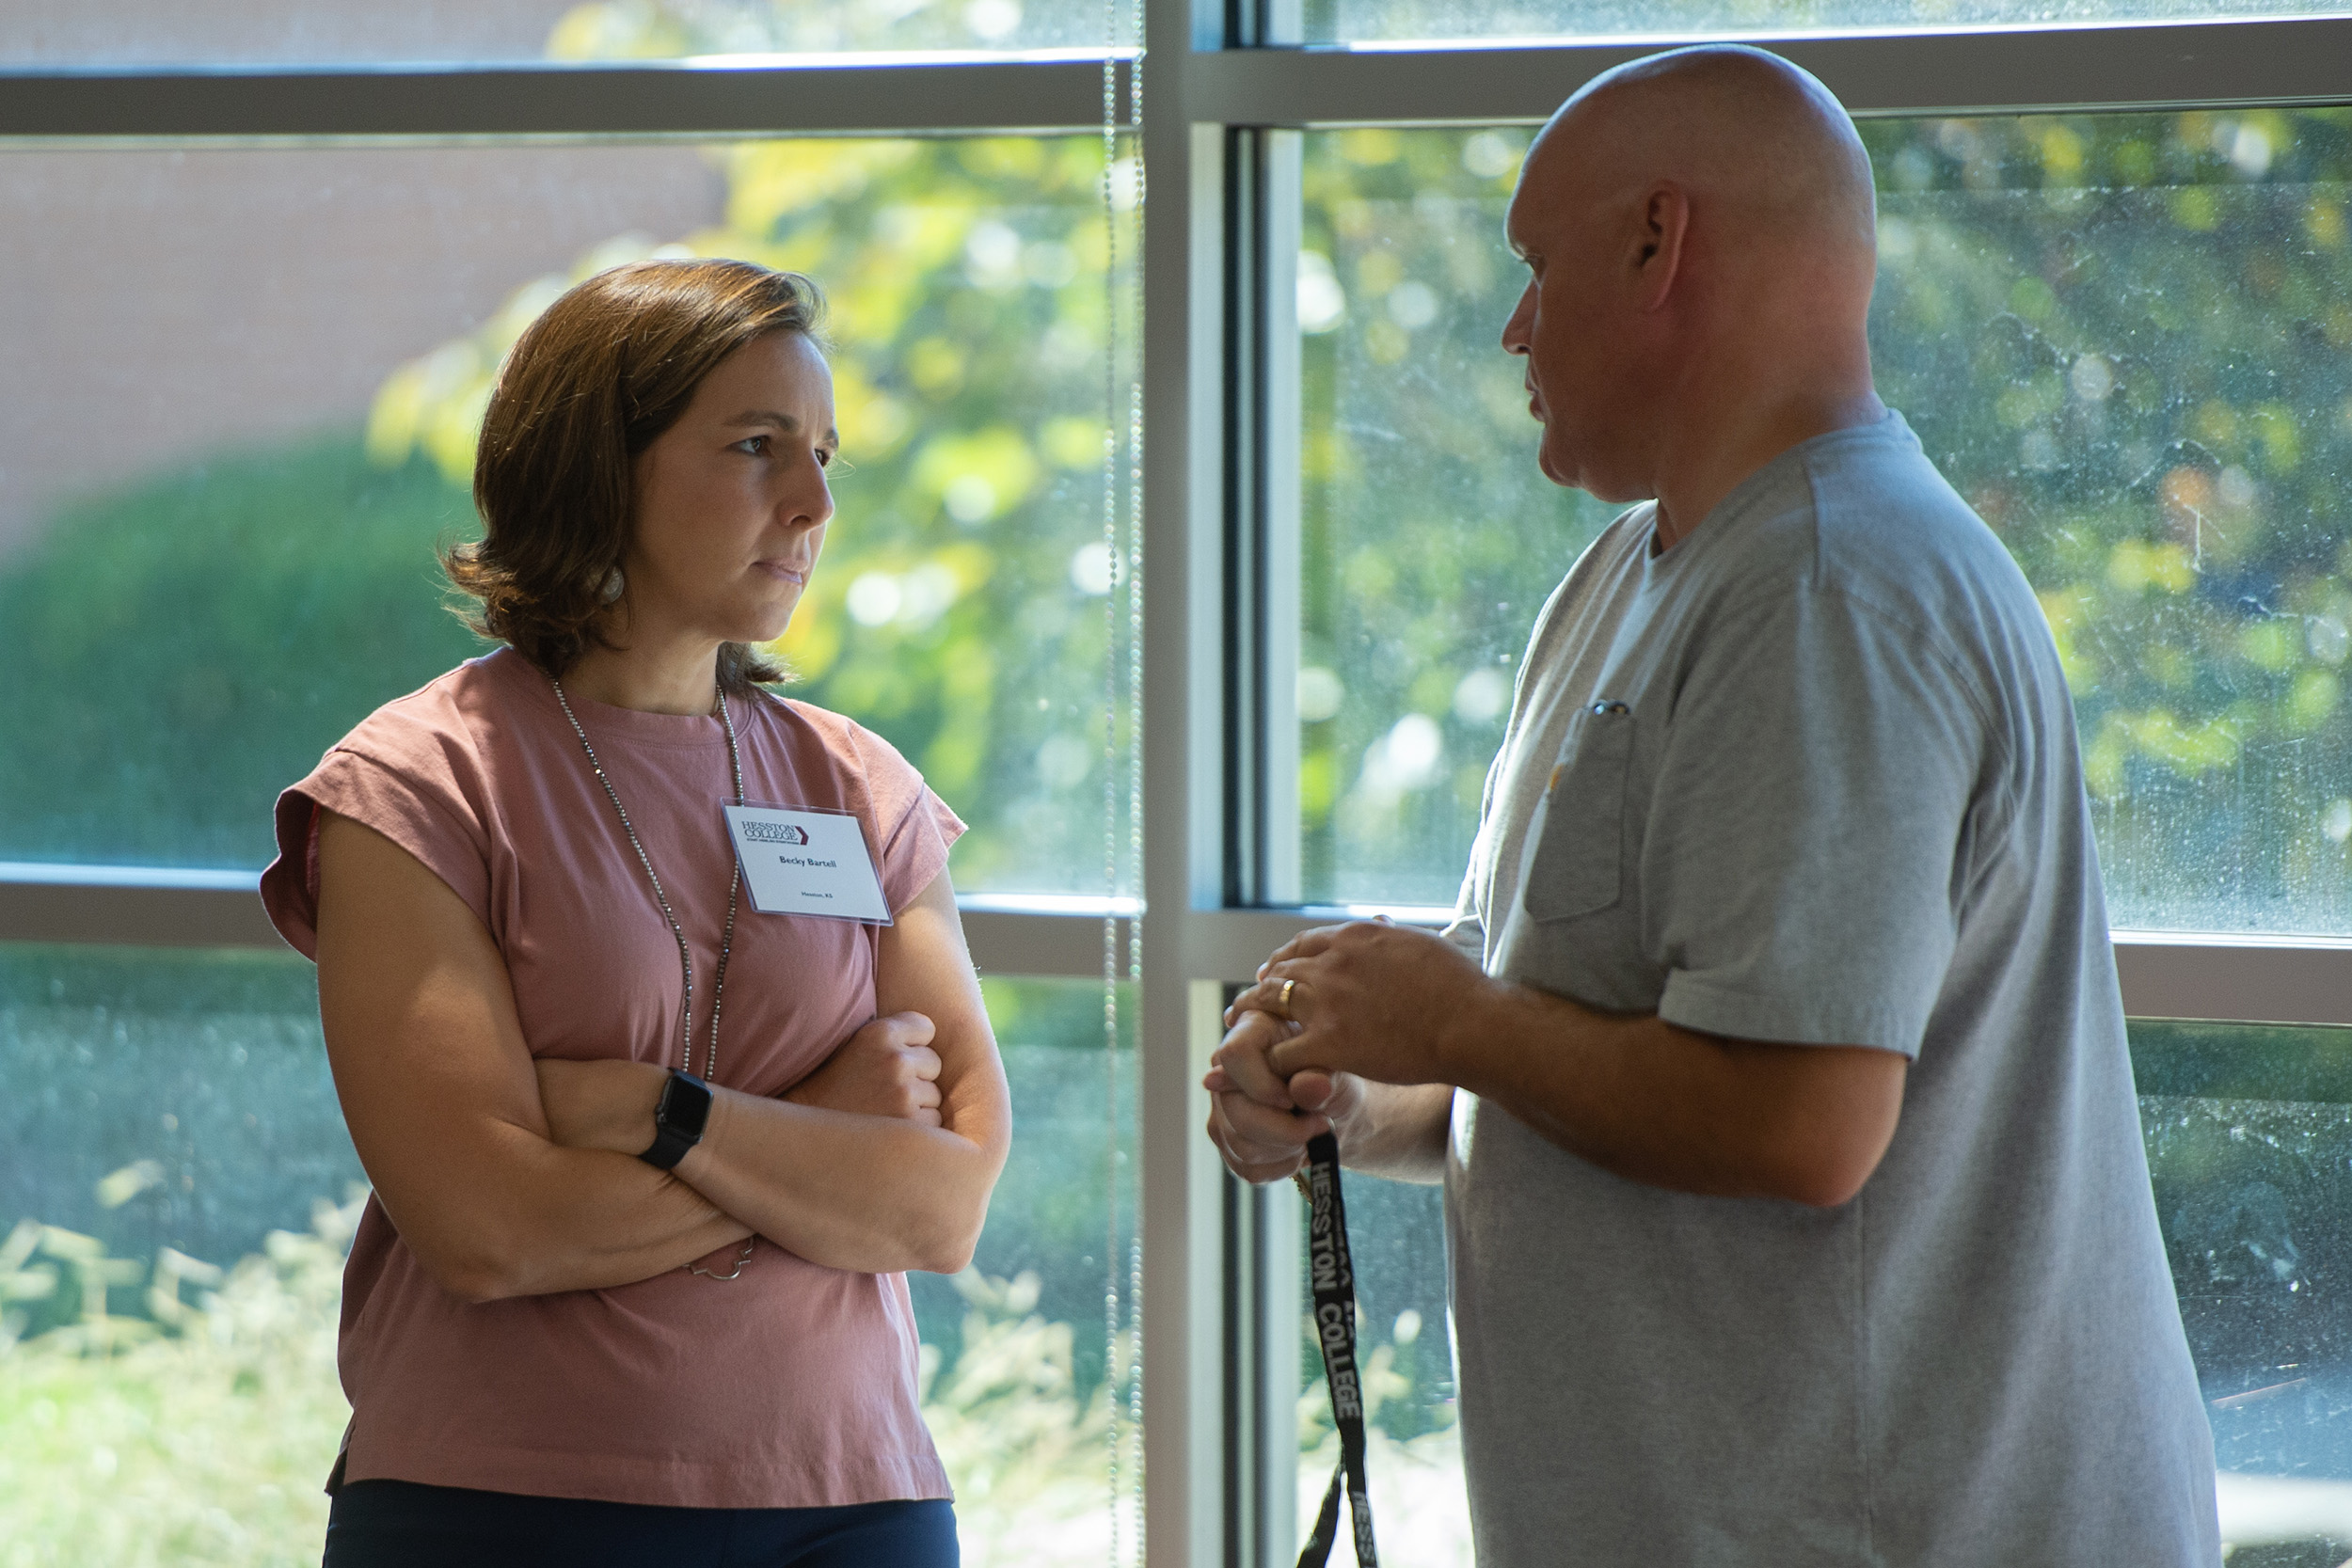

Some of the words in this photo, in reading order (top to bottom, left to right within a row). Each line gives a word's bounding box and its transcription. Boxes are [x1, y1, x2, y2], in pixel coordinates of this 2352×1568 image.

[741, 821, 795, 832] HESSTON
[744, 829, 798, 840] COLLEGE
[779, 855, 804, 867] Becky
[807, 858, 836, 867] Bartell
[1311, 1161, 1337, 1291] HESSTON
[1318, 1303, 1360, 1419] COLLEGE
[1351, 1486, 1376, 1568] HESS
